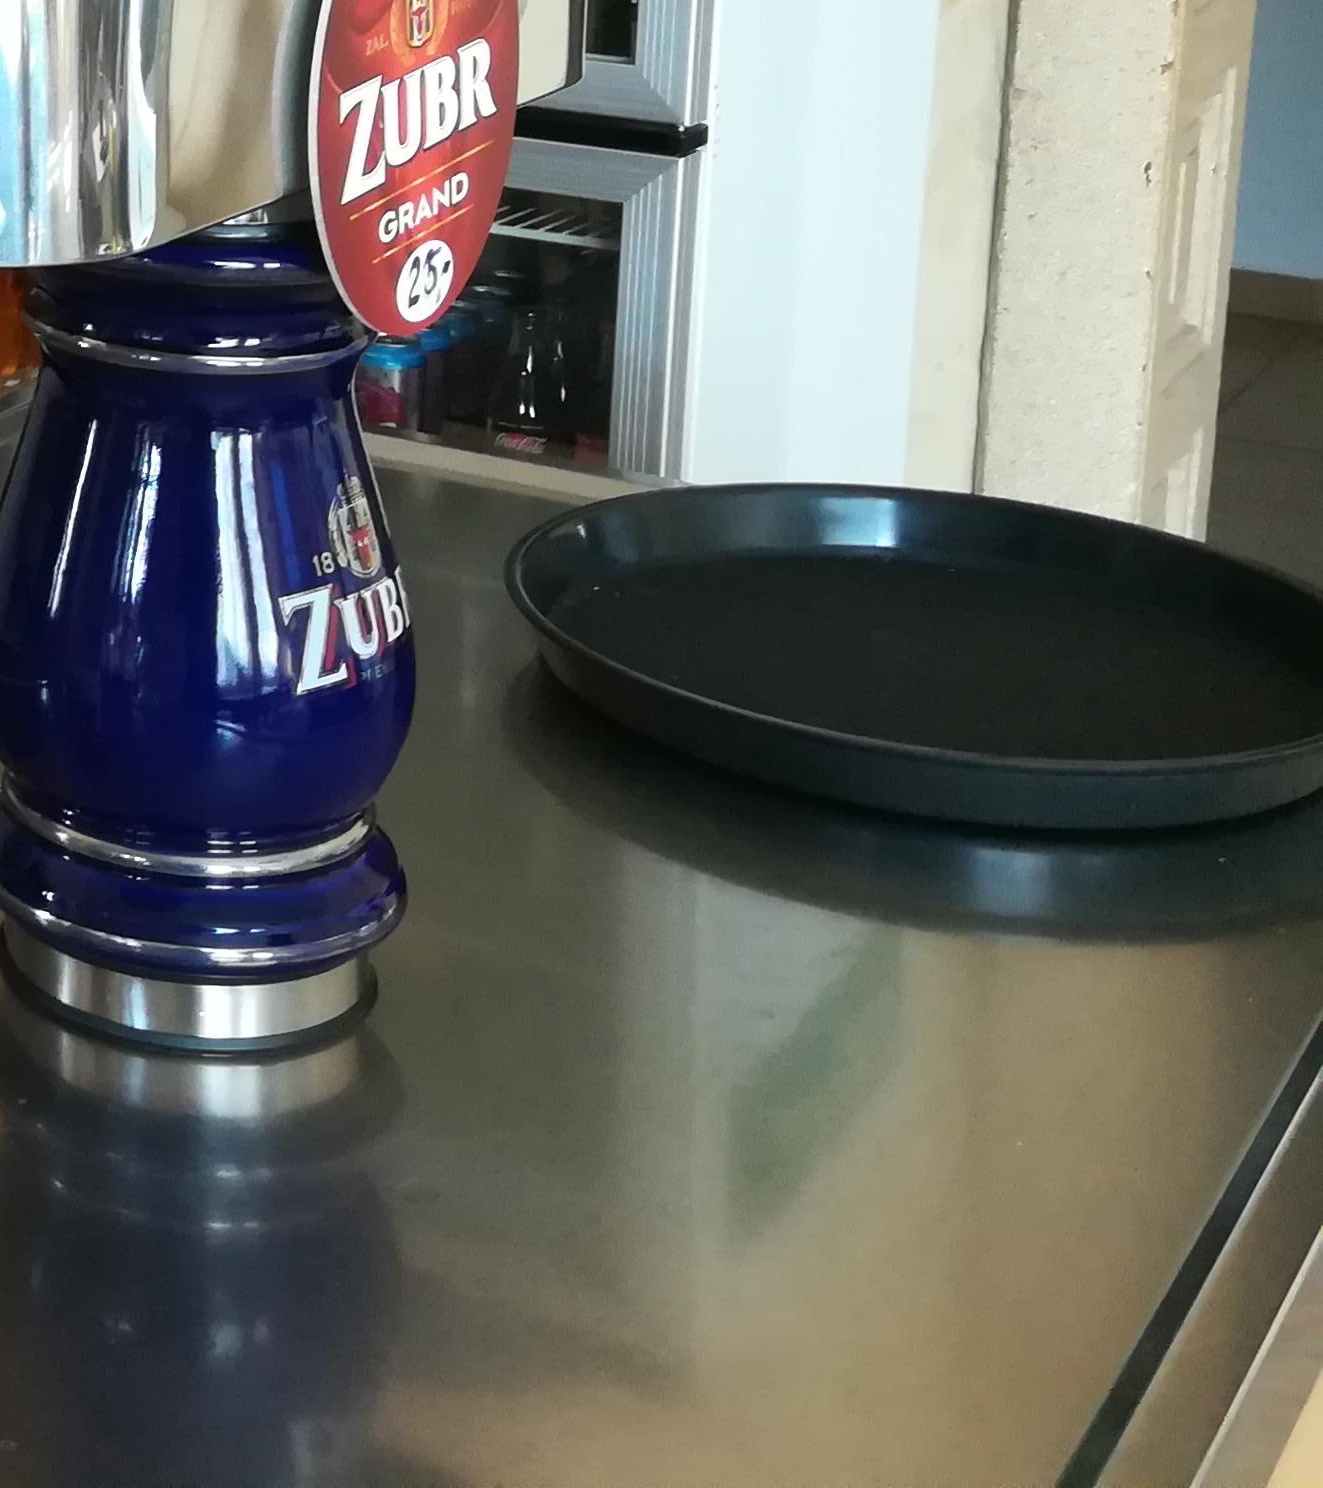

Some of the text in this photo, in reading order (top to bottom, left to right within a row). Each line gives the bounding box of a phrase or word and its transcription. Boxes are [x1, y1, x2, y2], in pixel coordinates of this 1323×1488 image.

[339, 38, 498, 206] ZUBR
[378, 171, 470, 245] GRAND
[312, 551, 336, 577] 18
